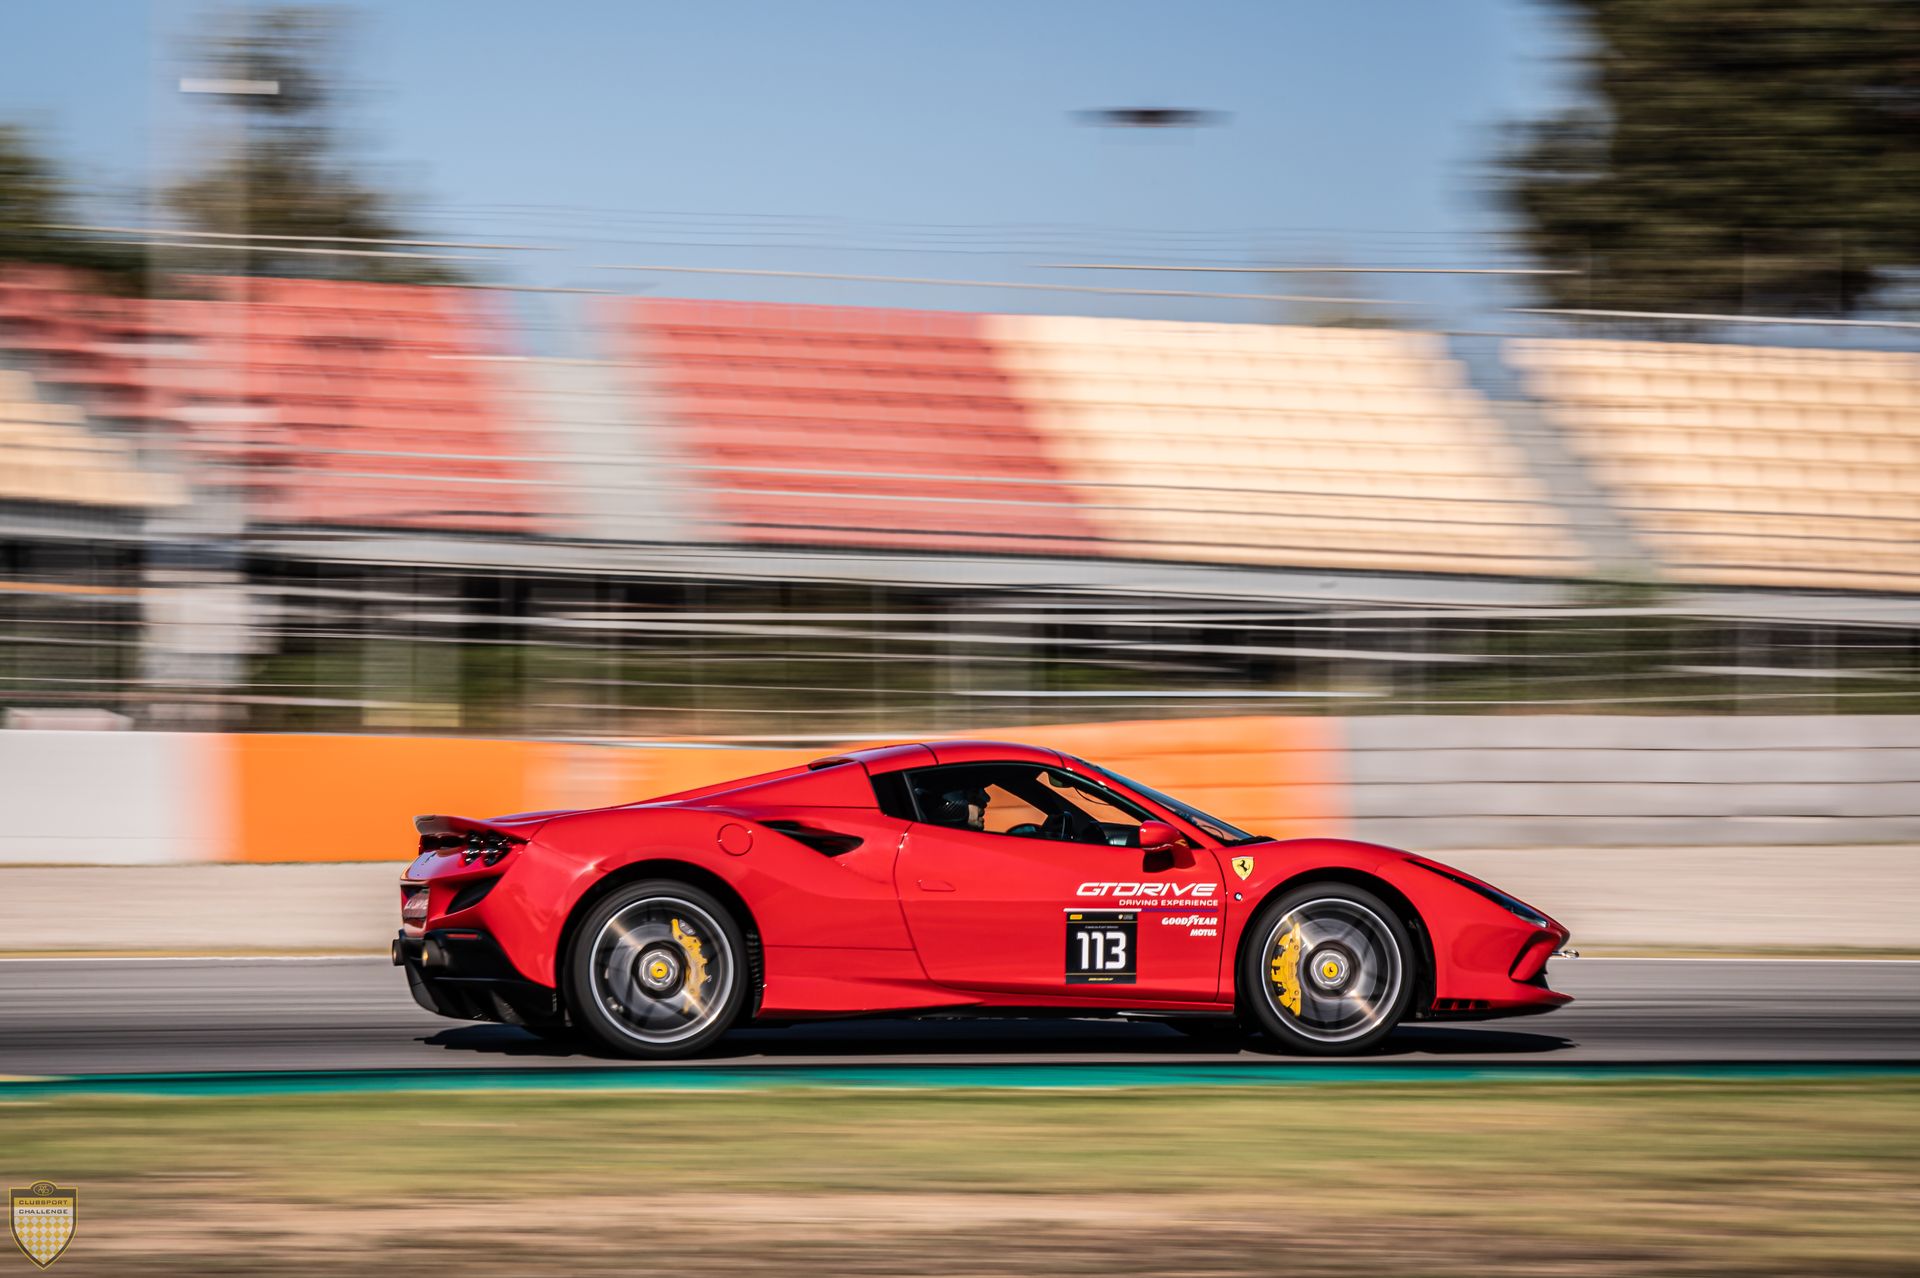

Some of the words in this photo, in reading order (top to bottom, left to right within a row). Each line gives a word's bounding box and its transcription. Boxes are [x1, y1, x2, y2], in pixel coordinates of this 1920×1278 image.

[1076, 882, 1218, 896] GTDRIVE
[1162, 915, 1217, 926] GOODYEAR
[1076, 931, 1127, 970] 113
